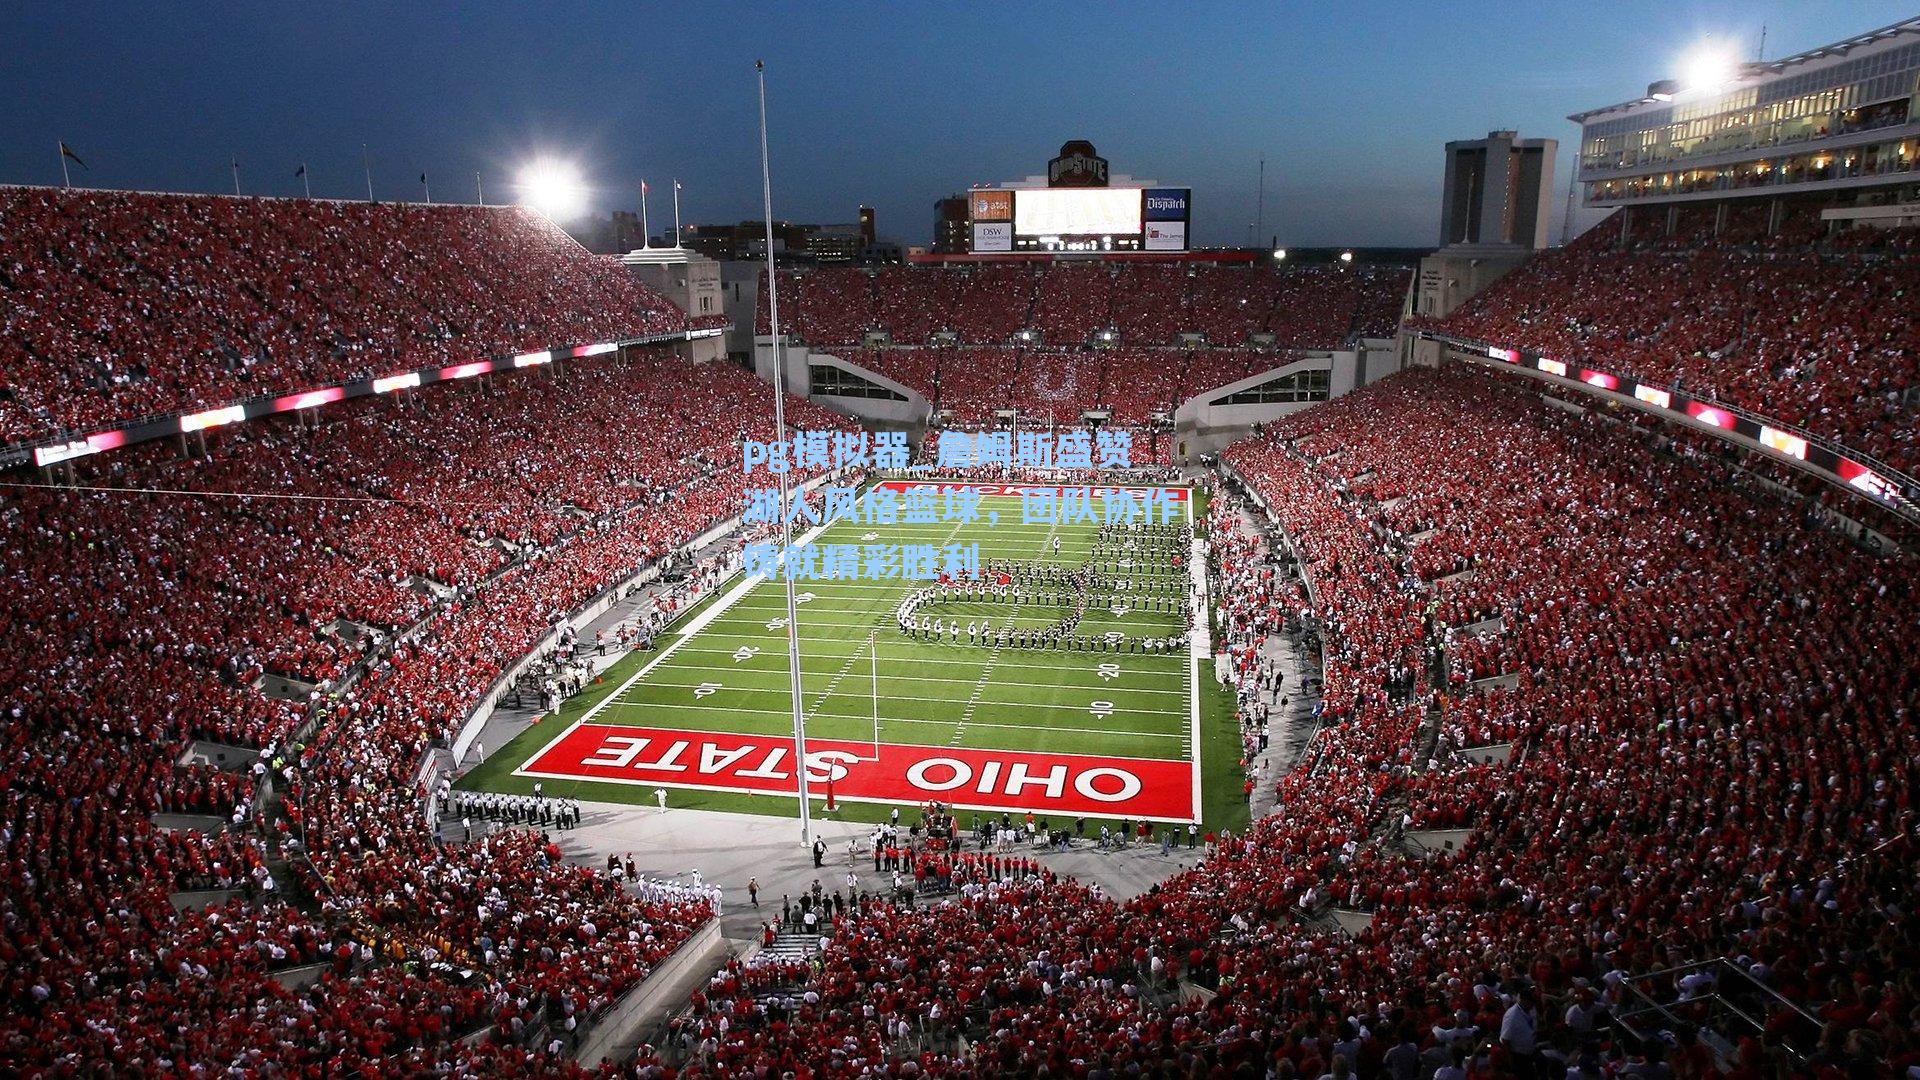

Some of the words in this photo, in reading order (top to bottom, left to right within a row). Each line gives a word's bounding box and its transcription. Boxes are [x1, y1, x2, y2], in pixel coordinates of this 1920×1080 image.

[1147, 197, 1185, 211] Dispatch
[983, 228, 1002, 236] DSW
[732, 646, 761, 660] 20
[1097, 663, 1120, 678] 20
[693, 683, 723, 696] 10
[1089, 700, 1114, 715] 10
[581, 735, 861, 783] STATE
[905, 757, 1143, 803] OHIO
